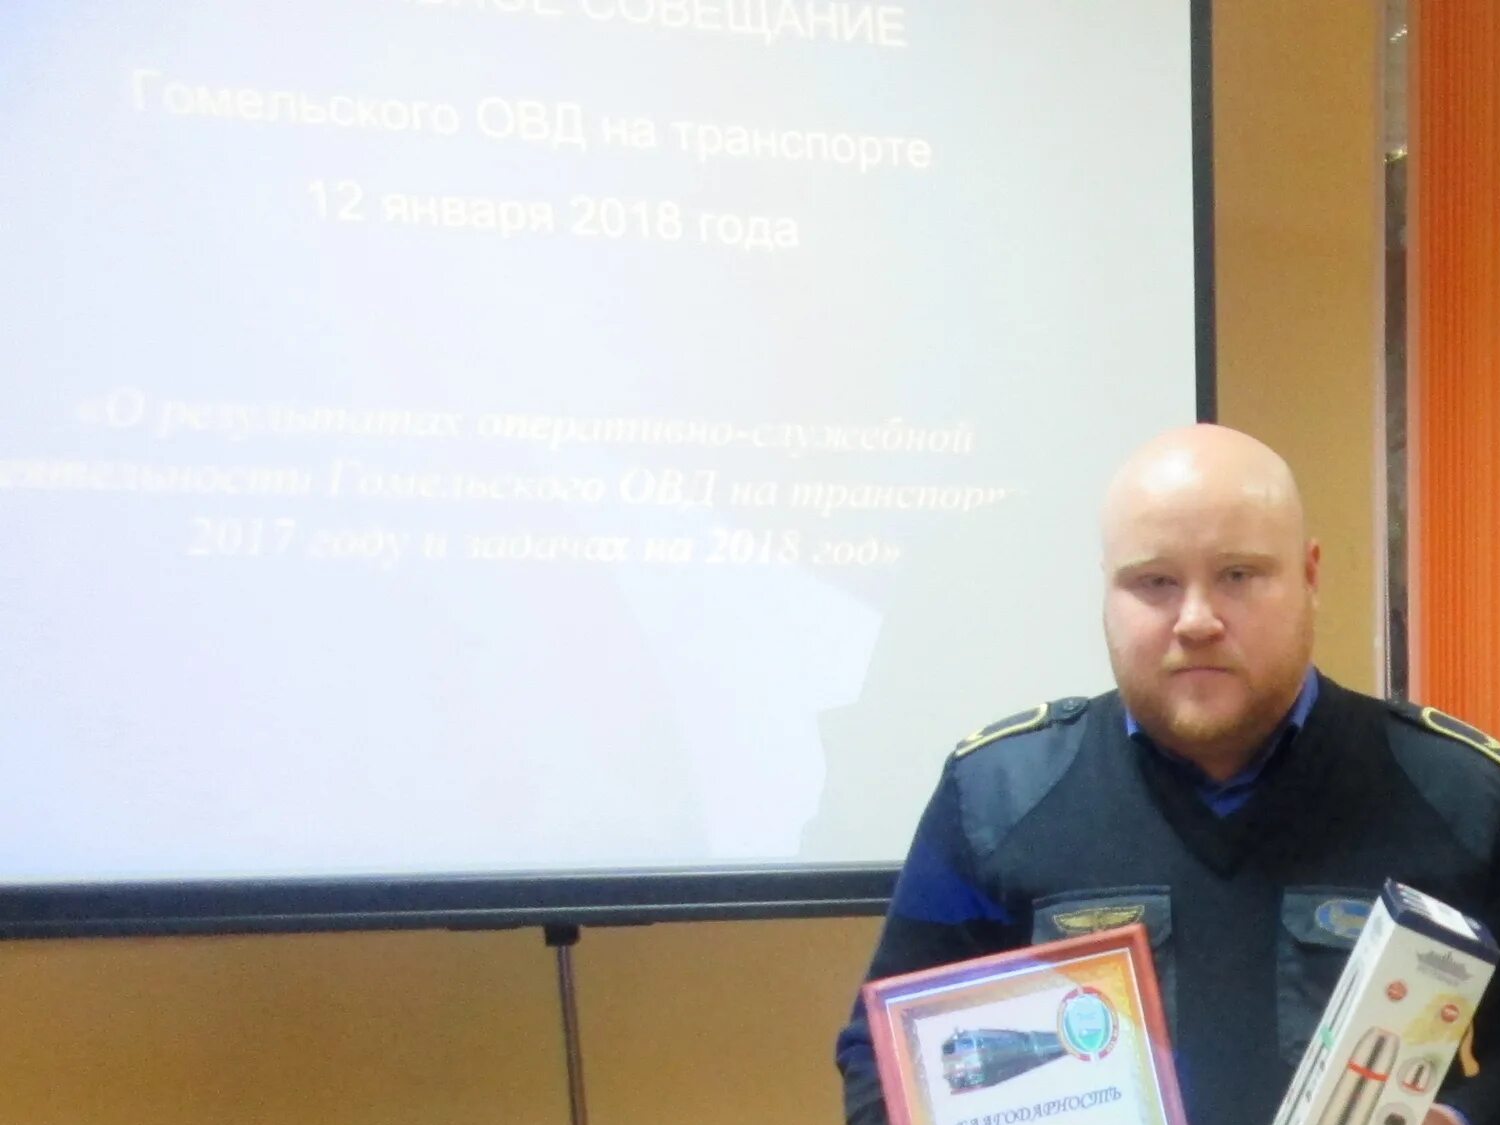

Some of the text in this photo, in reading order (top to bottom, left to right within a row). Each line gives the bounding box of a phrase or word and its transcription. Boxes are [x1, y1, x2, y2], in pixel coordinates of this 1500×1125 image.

[583, 0, 907, 48] СОВЕЩАНИЕ
[131, 66, 934, 173] Гомельского ОВД на транспорте
[307, 178, 801, 250] 12 января 2018 года
[327, 458, 606, 504] Гомельского
[619, 467, 719, 511] ОВД
[730, 479, 779, 507] на
[187, 516, 296, 558] 2017
[308, 522, 411, 572] году
[424, 531, 447, 560] и
[643, 534, 695, 563] на
[705, 527, 803, 566] 2018
